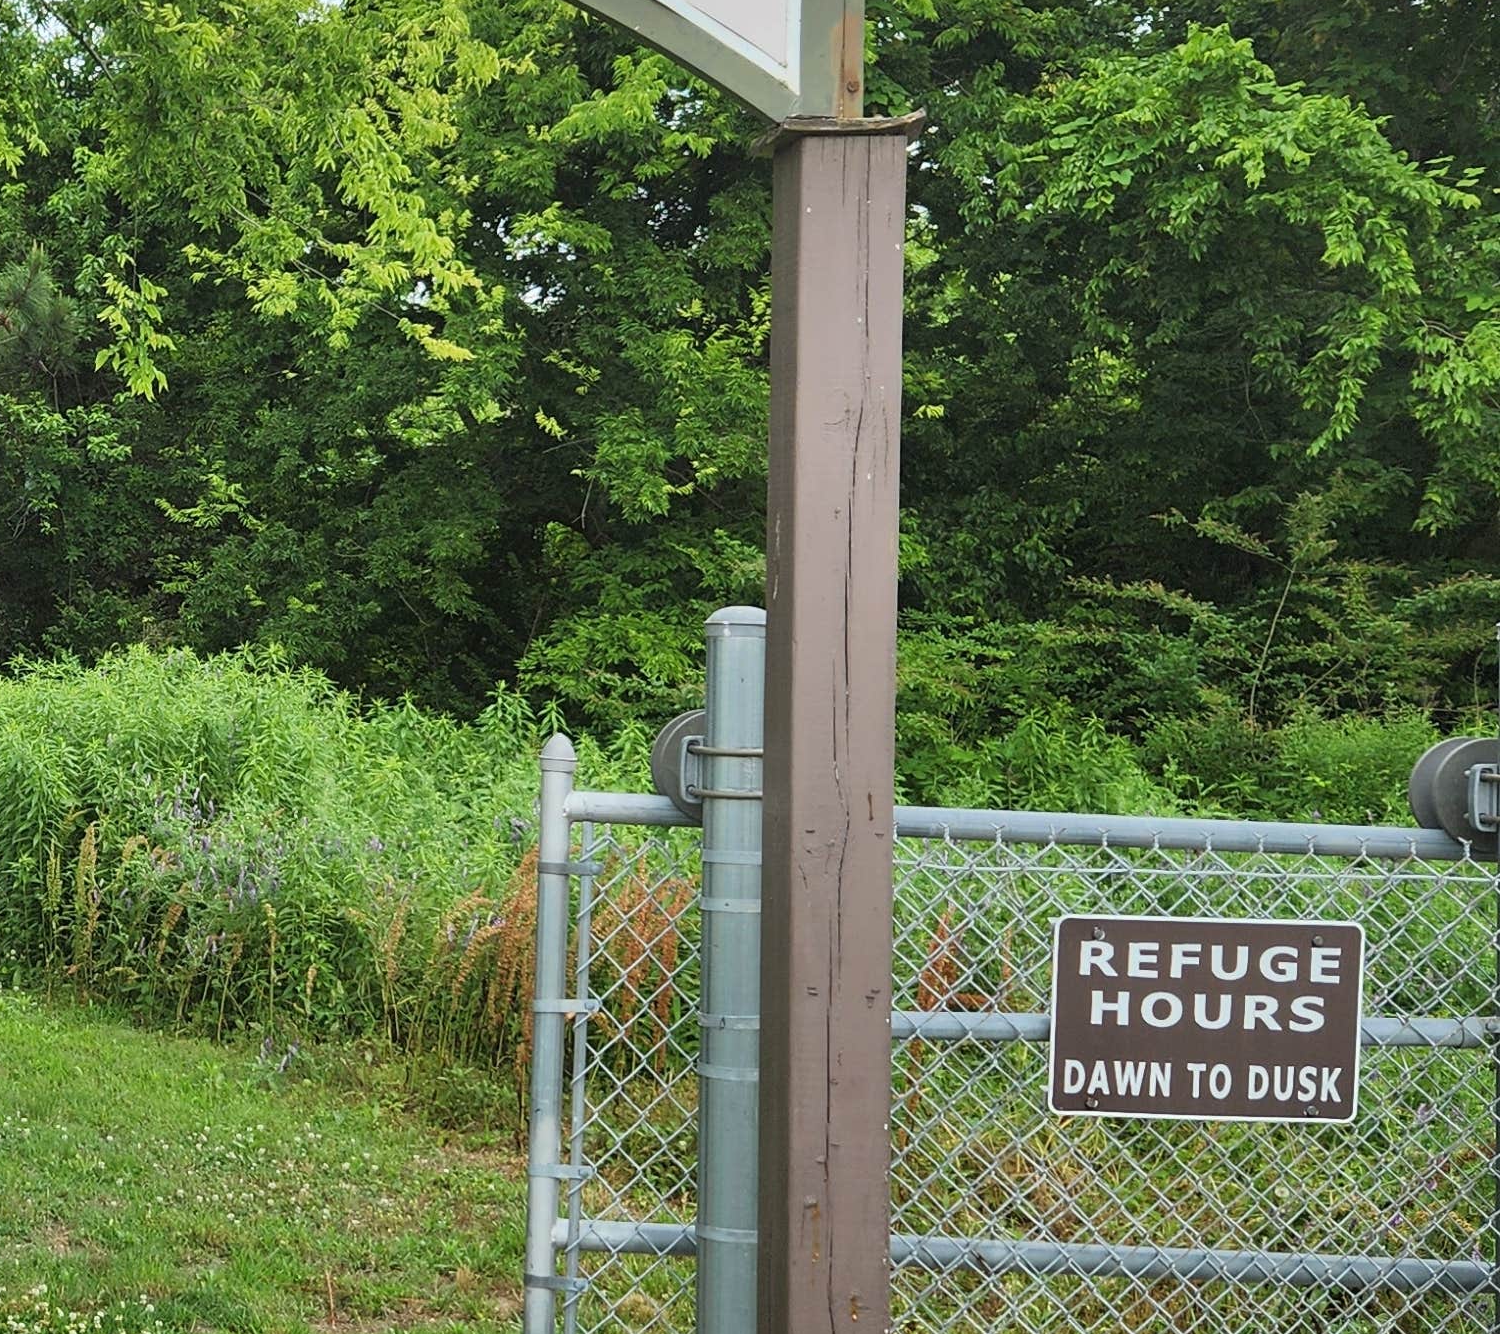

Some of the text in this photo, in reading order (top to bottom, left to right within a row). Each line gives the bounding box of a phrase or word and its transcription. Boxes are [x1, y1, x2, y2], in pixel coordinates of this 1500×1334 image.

[1078, 940, 1342, 984] REFUGE
[1090, 990, 1326, 1033] HOURS
[1063, 1058, 1343, 1103] DAWN TO DUSK
